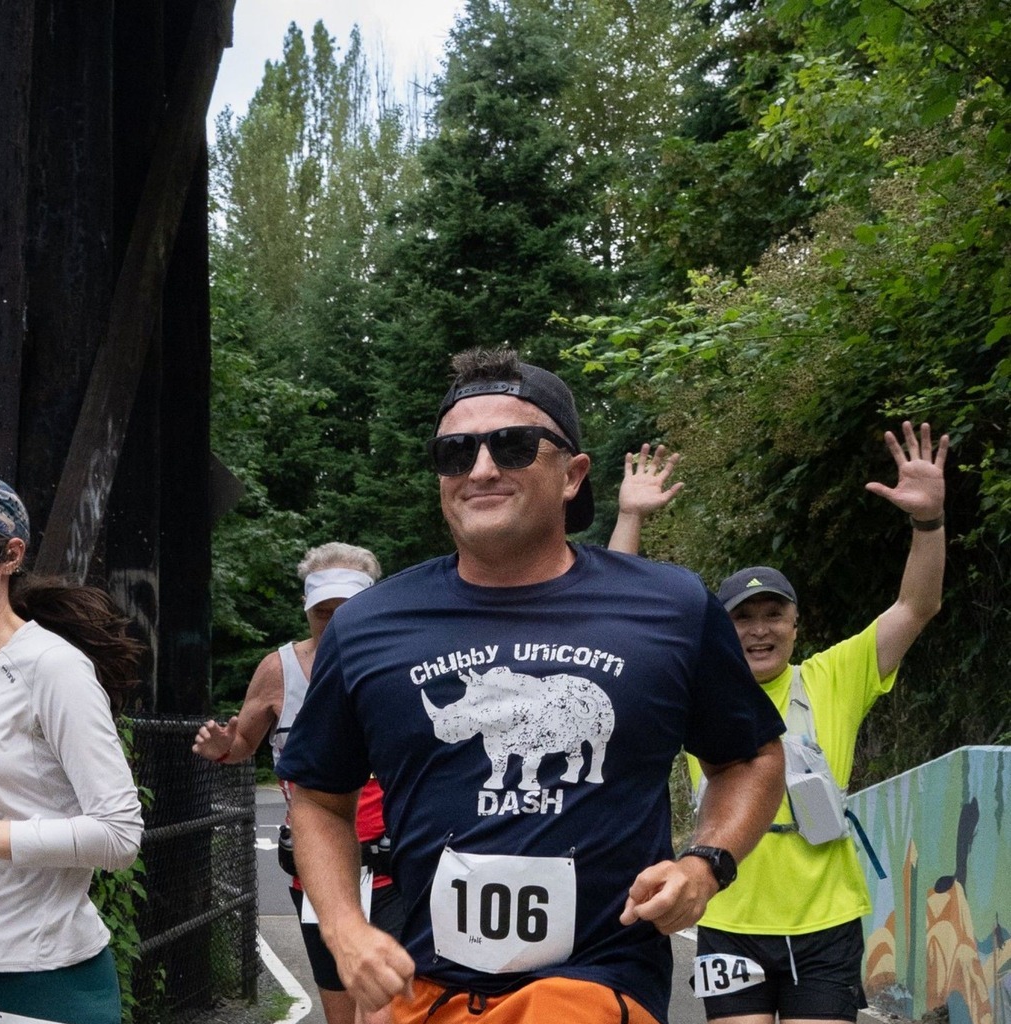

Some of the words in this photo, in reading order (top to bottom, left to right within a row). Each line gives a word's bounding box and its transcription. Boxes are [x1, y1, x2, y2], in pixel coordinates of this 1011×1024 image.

[477, 789, 564, 816] DASH
[451, 878, 549, 943] 106
[699, 958, 750, 991] 134
